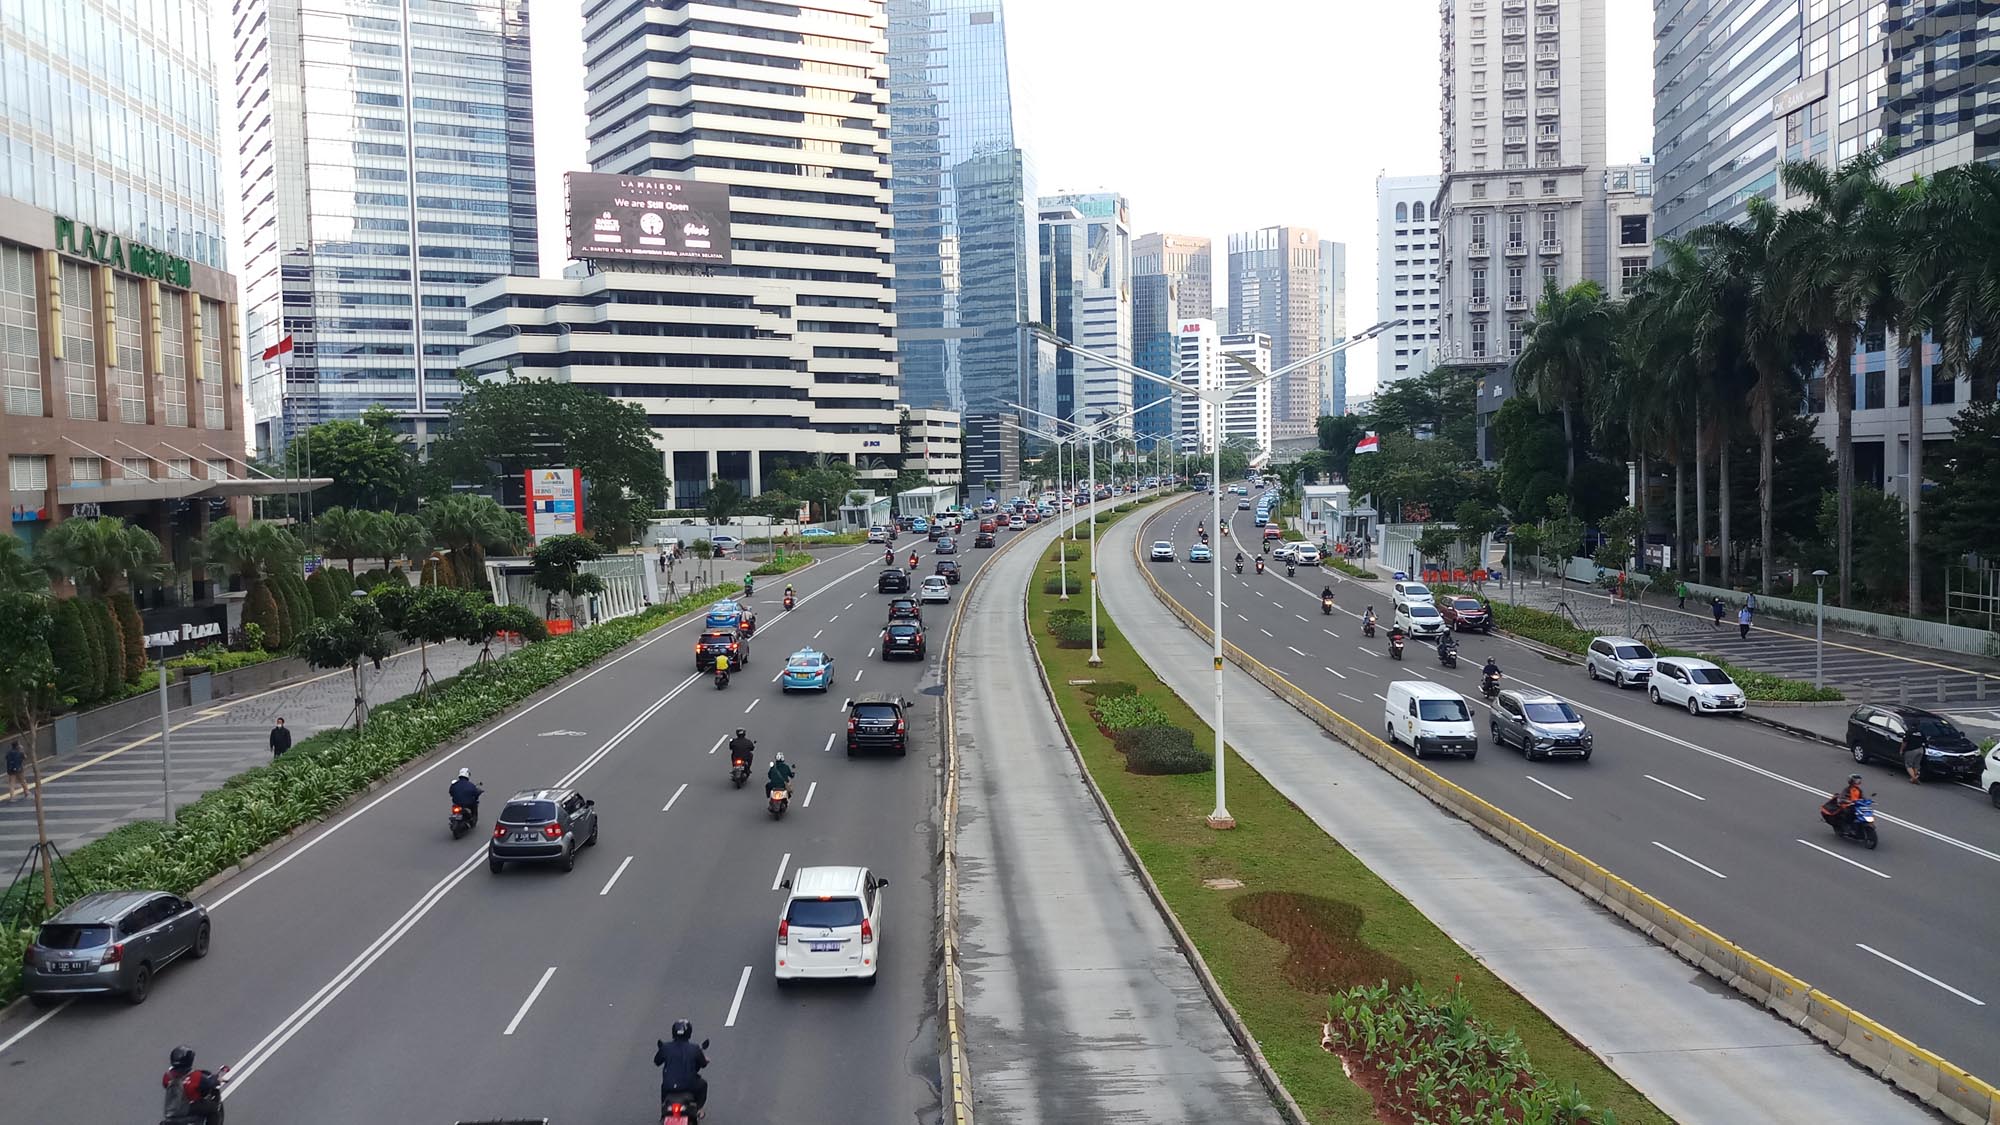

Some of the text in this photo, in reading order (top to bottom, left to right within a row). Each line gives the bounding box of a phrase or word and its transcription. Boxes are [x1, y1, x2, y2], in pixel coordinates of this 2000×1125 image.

[638, 181, 682, 191] MAISON
[614, 198, 629, 207] We
[647, 200, 664, 209] Still
[665, 202, 689, 211] Open
[54, 216, 126, 270] PLAZA
[1182, 324, 1201, 333] ABB
[181, 622, 222, 641] PLAZA
